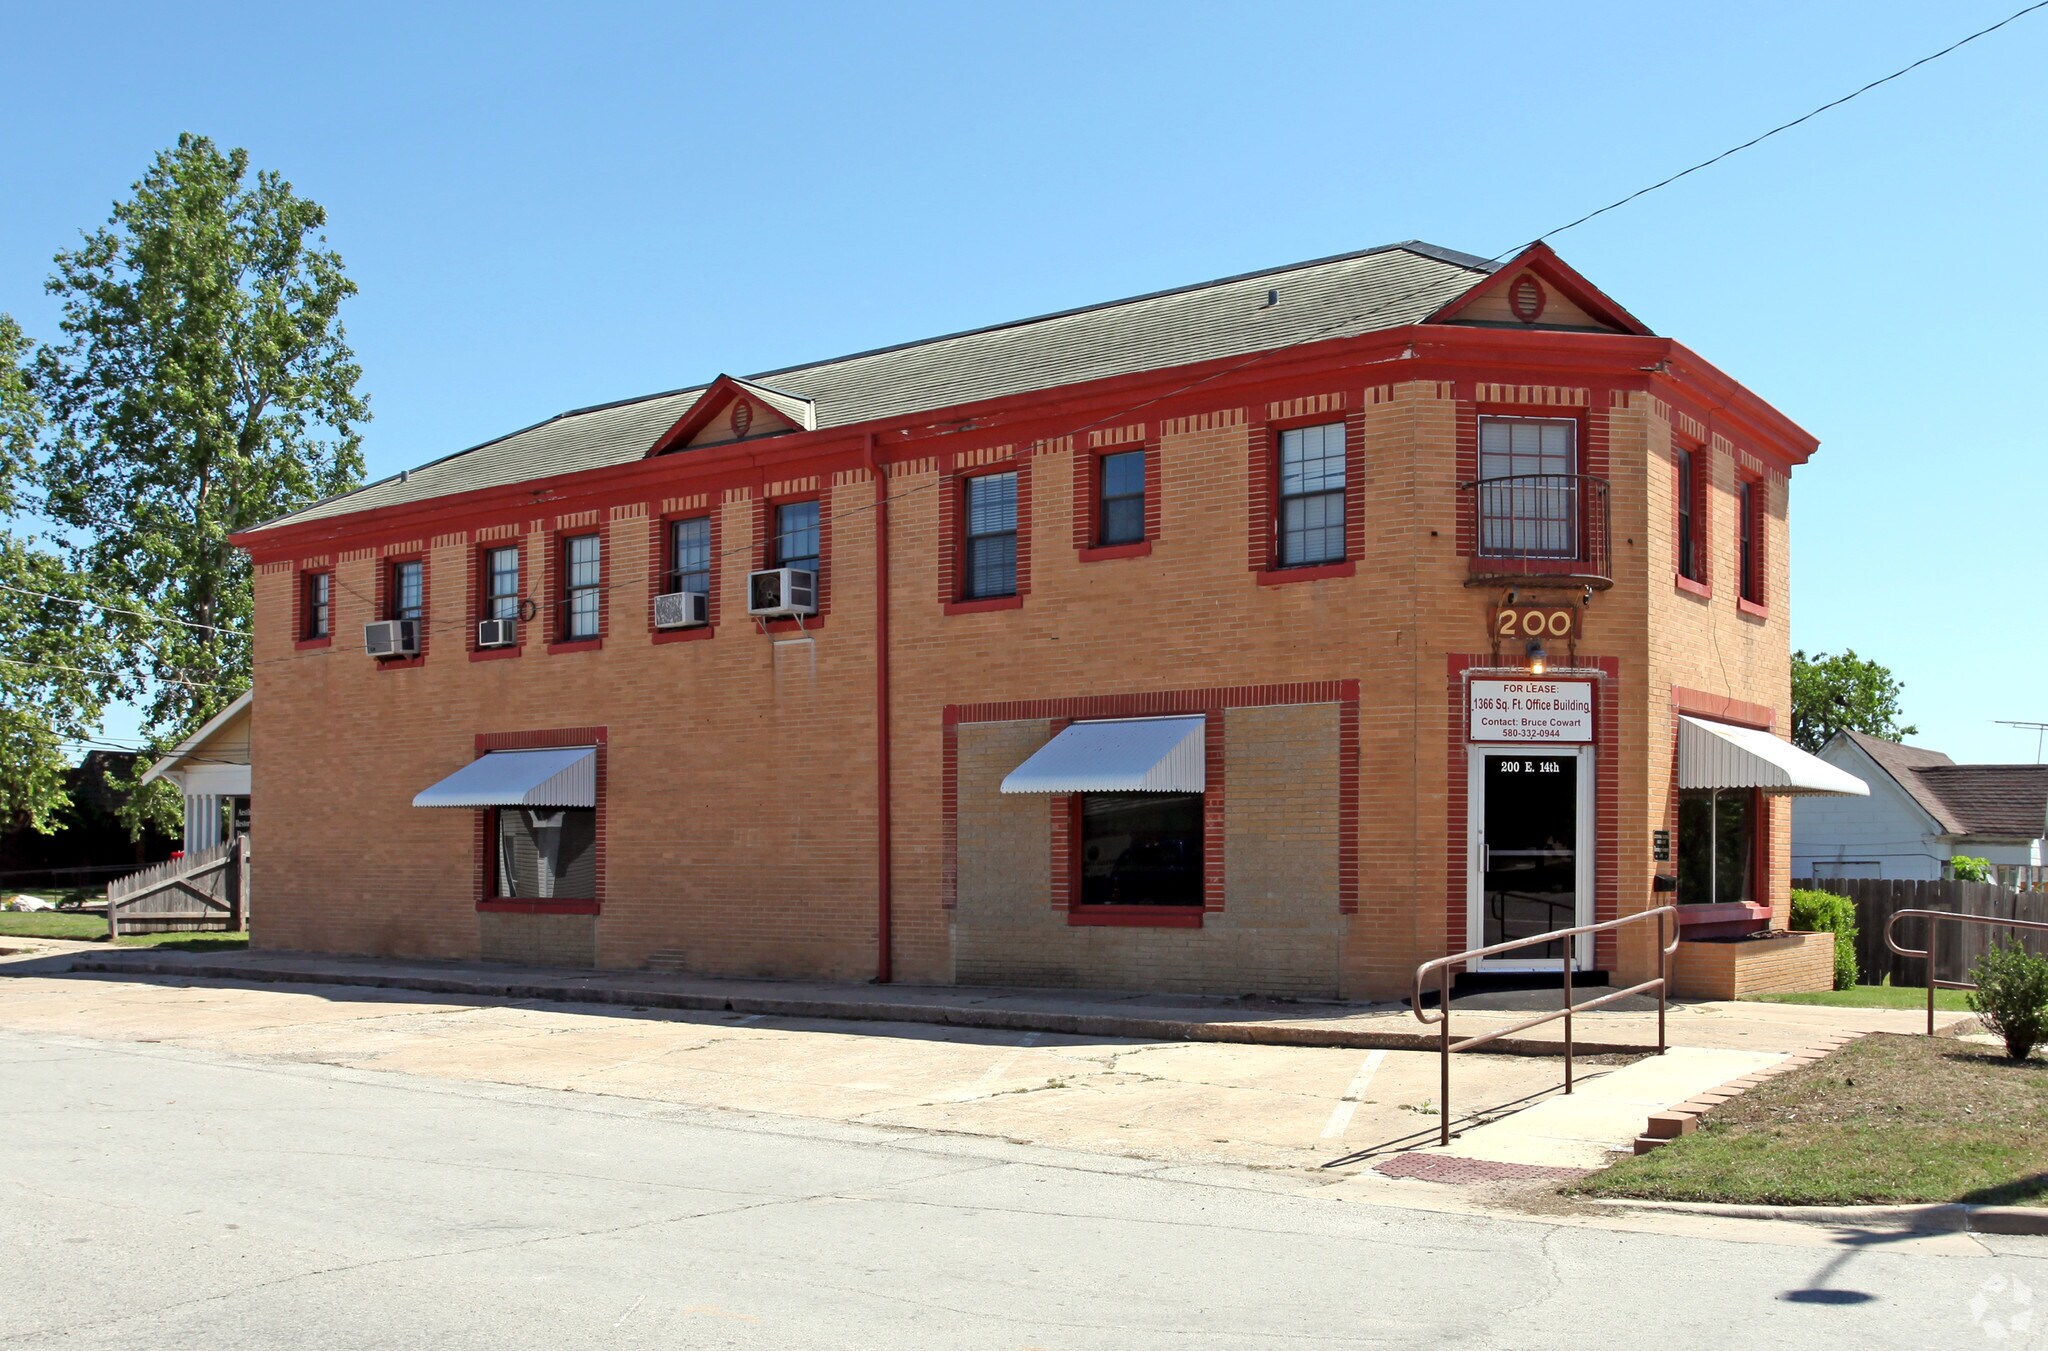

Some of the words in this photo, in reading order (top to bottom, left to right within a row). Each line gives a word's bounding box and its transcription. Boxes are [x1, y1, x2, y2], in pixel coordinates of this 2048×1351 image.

[1499, 609, 1571, 636] 200
[1503, 684, 1523, 693] FOR
[1526, 684, 1559, 694] LEASE:
[1474, 698, 1494, 710] 1366
[1495, 698, 1510, 712] Sq.
[1512, 698, 1524, 710] Ft.
[1526, 698, 1551, 711] Office
[1553, 699, 1590, 714] Building
[1481, 717, 1519, 726] Contact:
[1521, 717, 1547, 727] Bruce
[1550, 718, 1581, 727] Cowart
[1502, 728, 1560, 738] 580-332-0944
[1500, 761, 1520, 773] 200
[1524, 761, 1535, 773] E.
[1539, 761, 1560, 773] 14th
